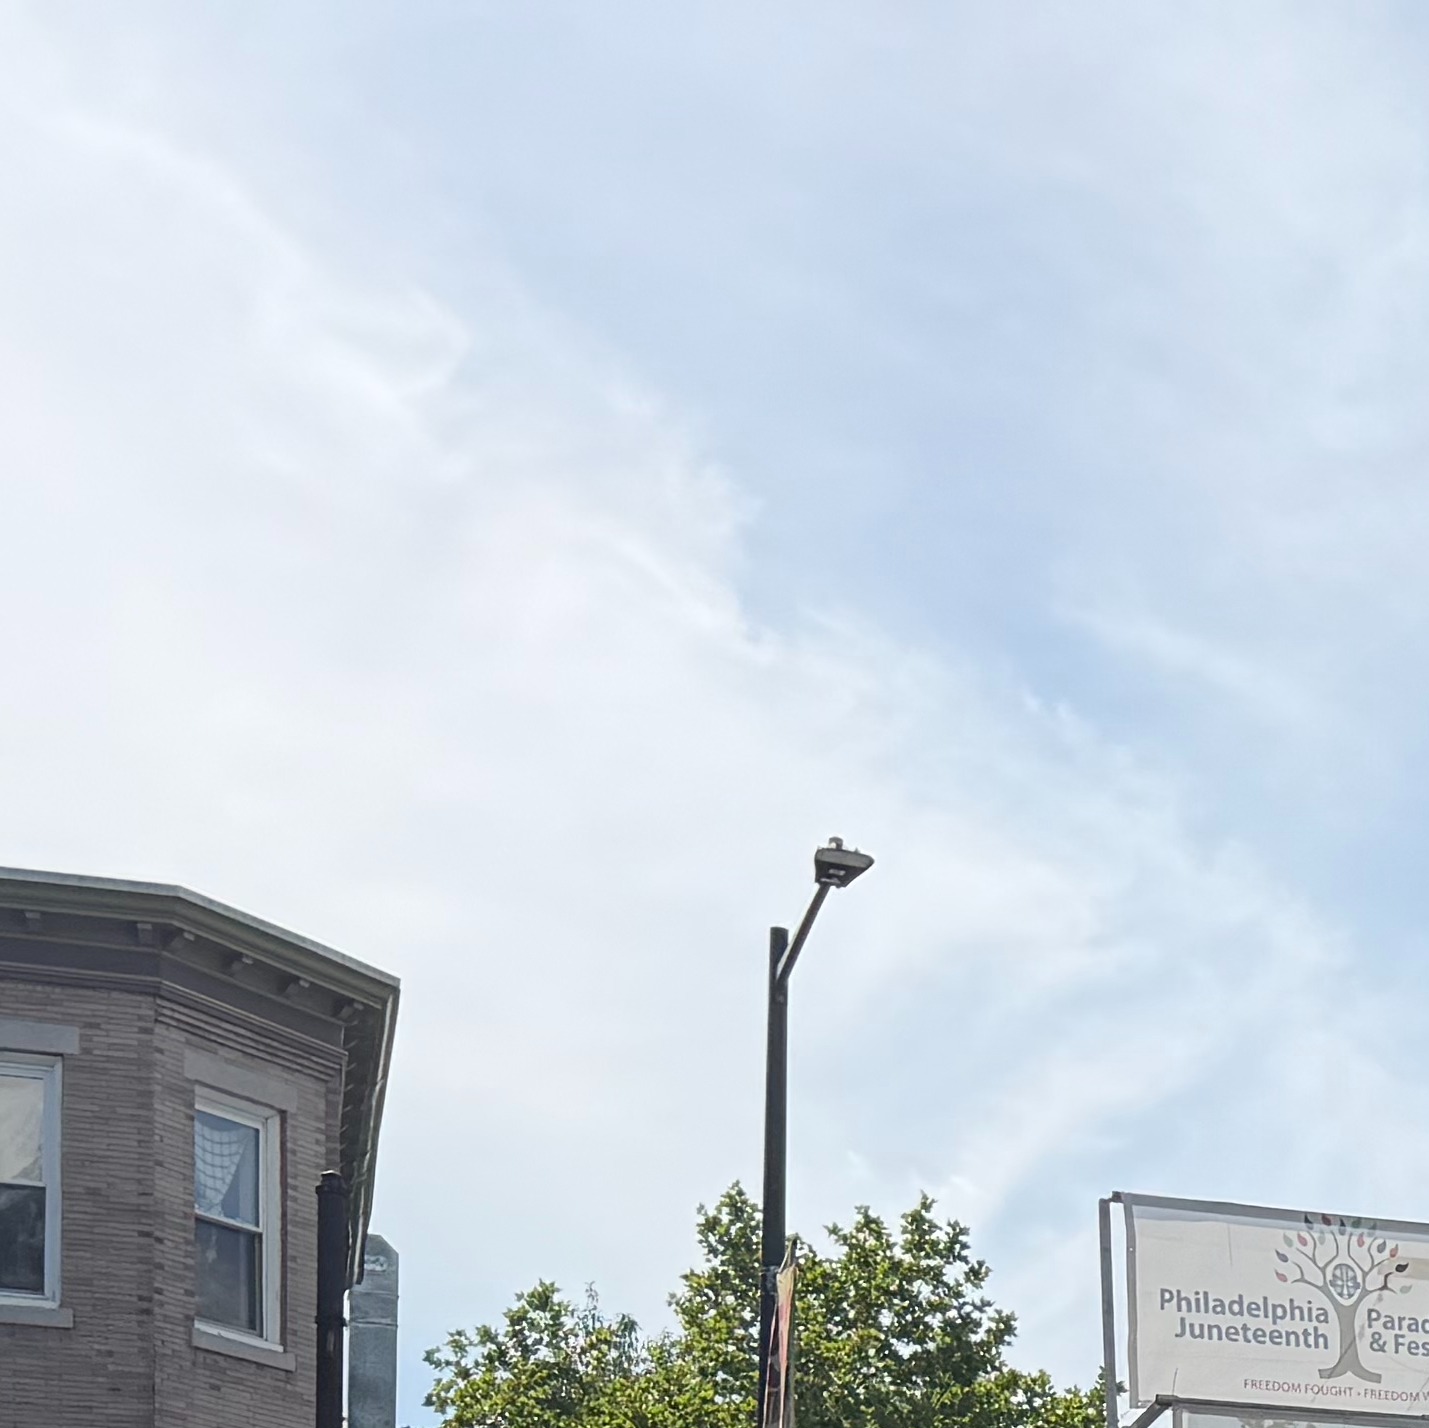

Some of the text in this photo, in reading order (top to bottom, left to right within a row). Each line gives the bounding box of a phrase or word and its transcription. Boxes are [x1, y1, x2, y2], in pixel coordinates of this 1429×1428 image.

[1159, 1287, 1329, 1325] Philadelphia
[1174, 1316, 1329, 1350] Juneteenth
[1369, 1334, 1387, 1353] &
[1244, 1379, 1300, 1393] FREEDOM
[1304, 1382, 1354, 1395] FOUGHT
[1363, 1387, 1420, 1401] FREEDOM
